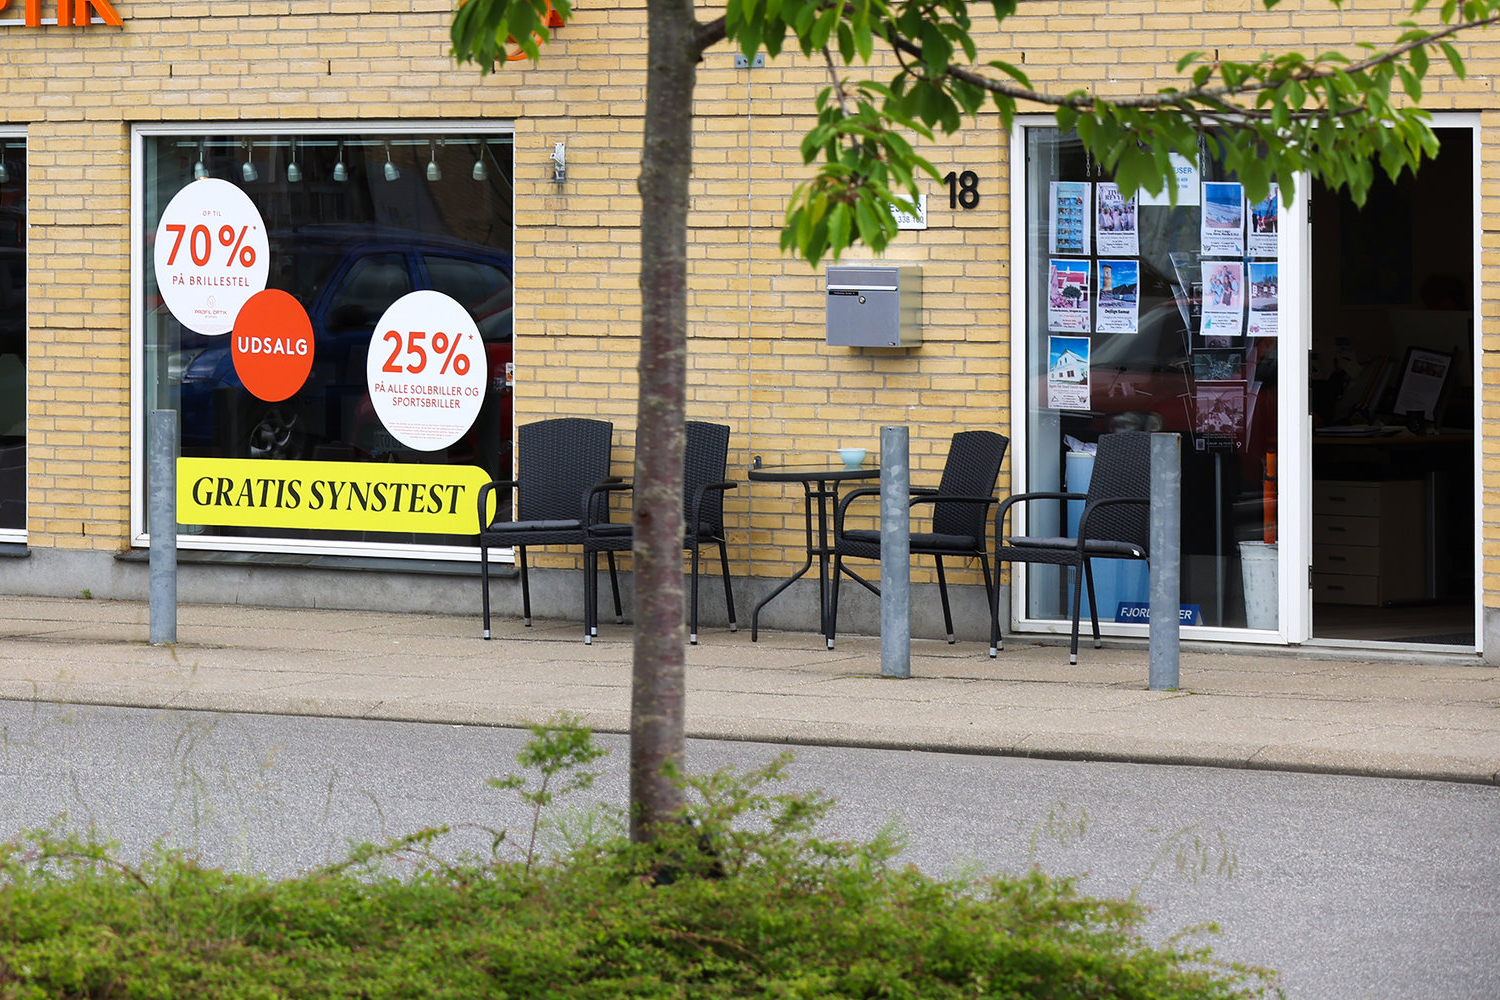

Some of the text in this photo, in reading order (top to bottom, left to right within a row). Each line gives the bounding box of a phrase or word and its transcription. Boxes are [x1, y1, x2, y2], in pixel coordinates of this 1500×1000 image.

[944, 171, 980, 209] 18
[172, 273, 250, 287] PÅ BRILLESTEL
[238, 337, 308, 355] UDSALG
[375, 381, 479, 397] PÅ ALLE SOLBRILLER OG
[393, 397, 460, 408] SPORTSBRILLER
[192, 477, 466, 514] GRATIS SYNSTEST
